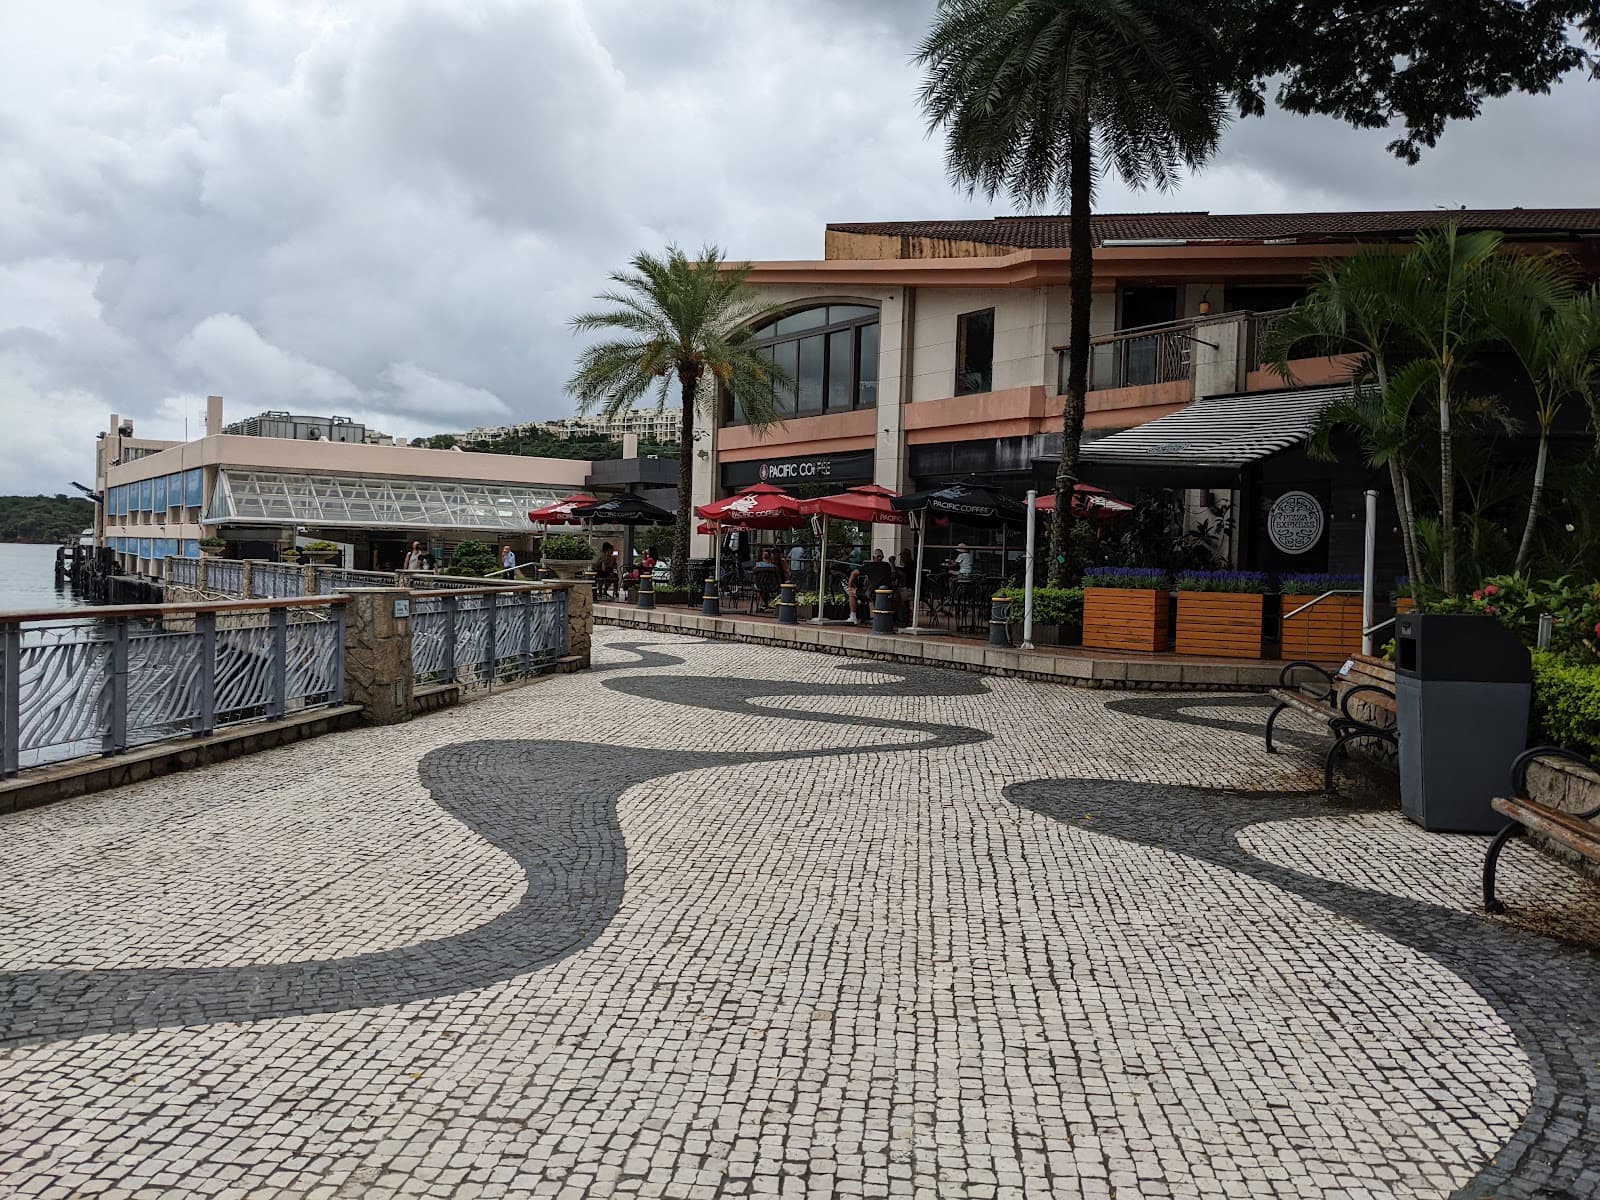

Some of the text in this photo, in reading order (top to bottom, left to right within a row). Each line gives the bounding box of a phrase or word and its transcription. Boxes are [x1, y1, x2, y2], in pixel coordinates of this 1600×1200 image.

[769, 463, 798, 478] PACIFIC
[933, 500, 990, 514] PACIFIC COFFEE
[731, 511, 755, 519] PACIFIC
[1275, 521, 1316, 529] EXPRESS
